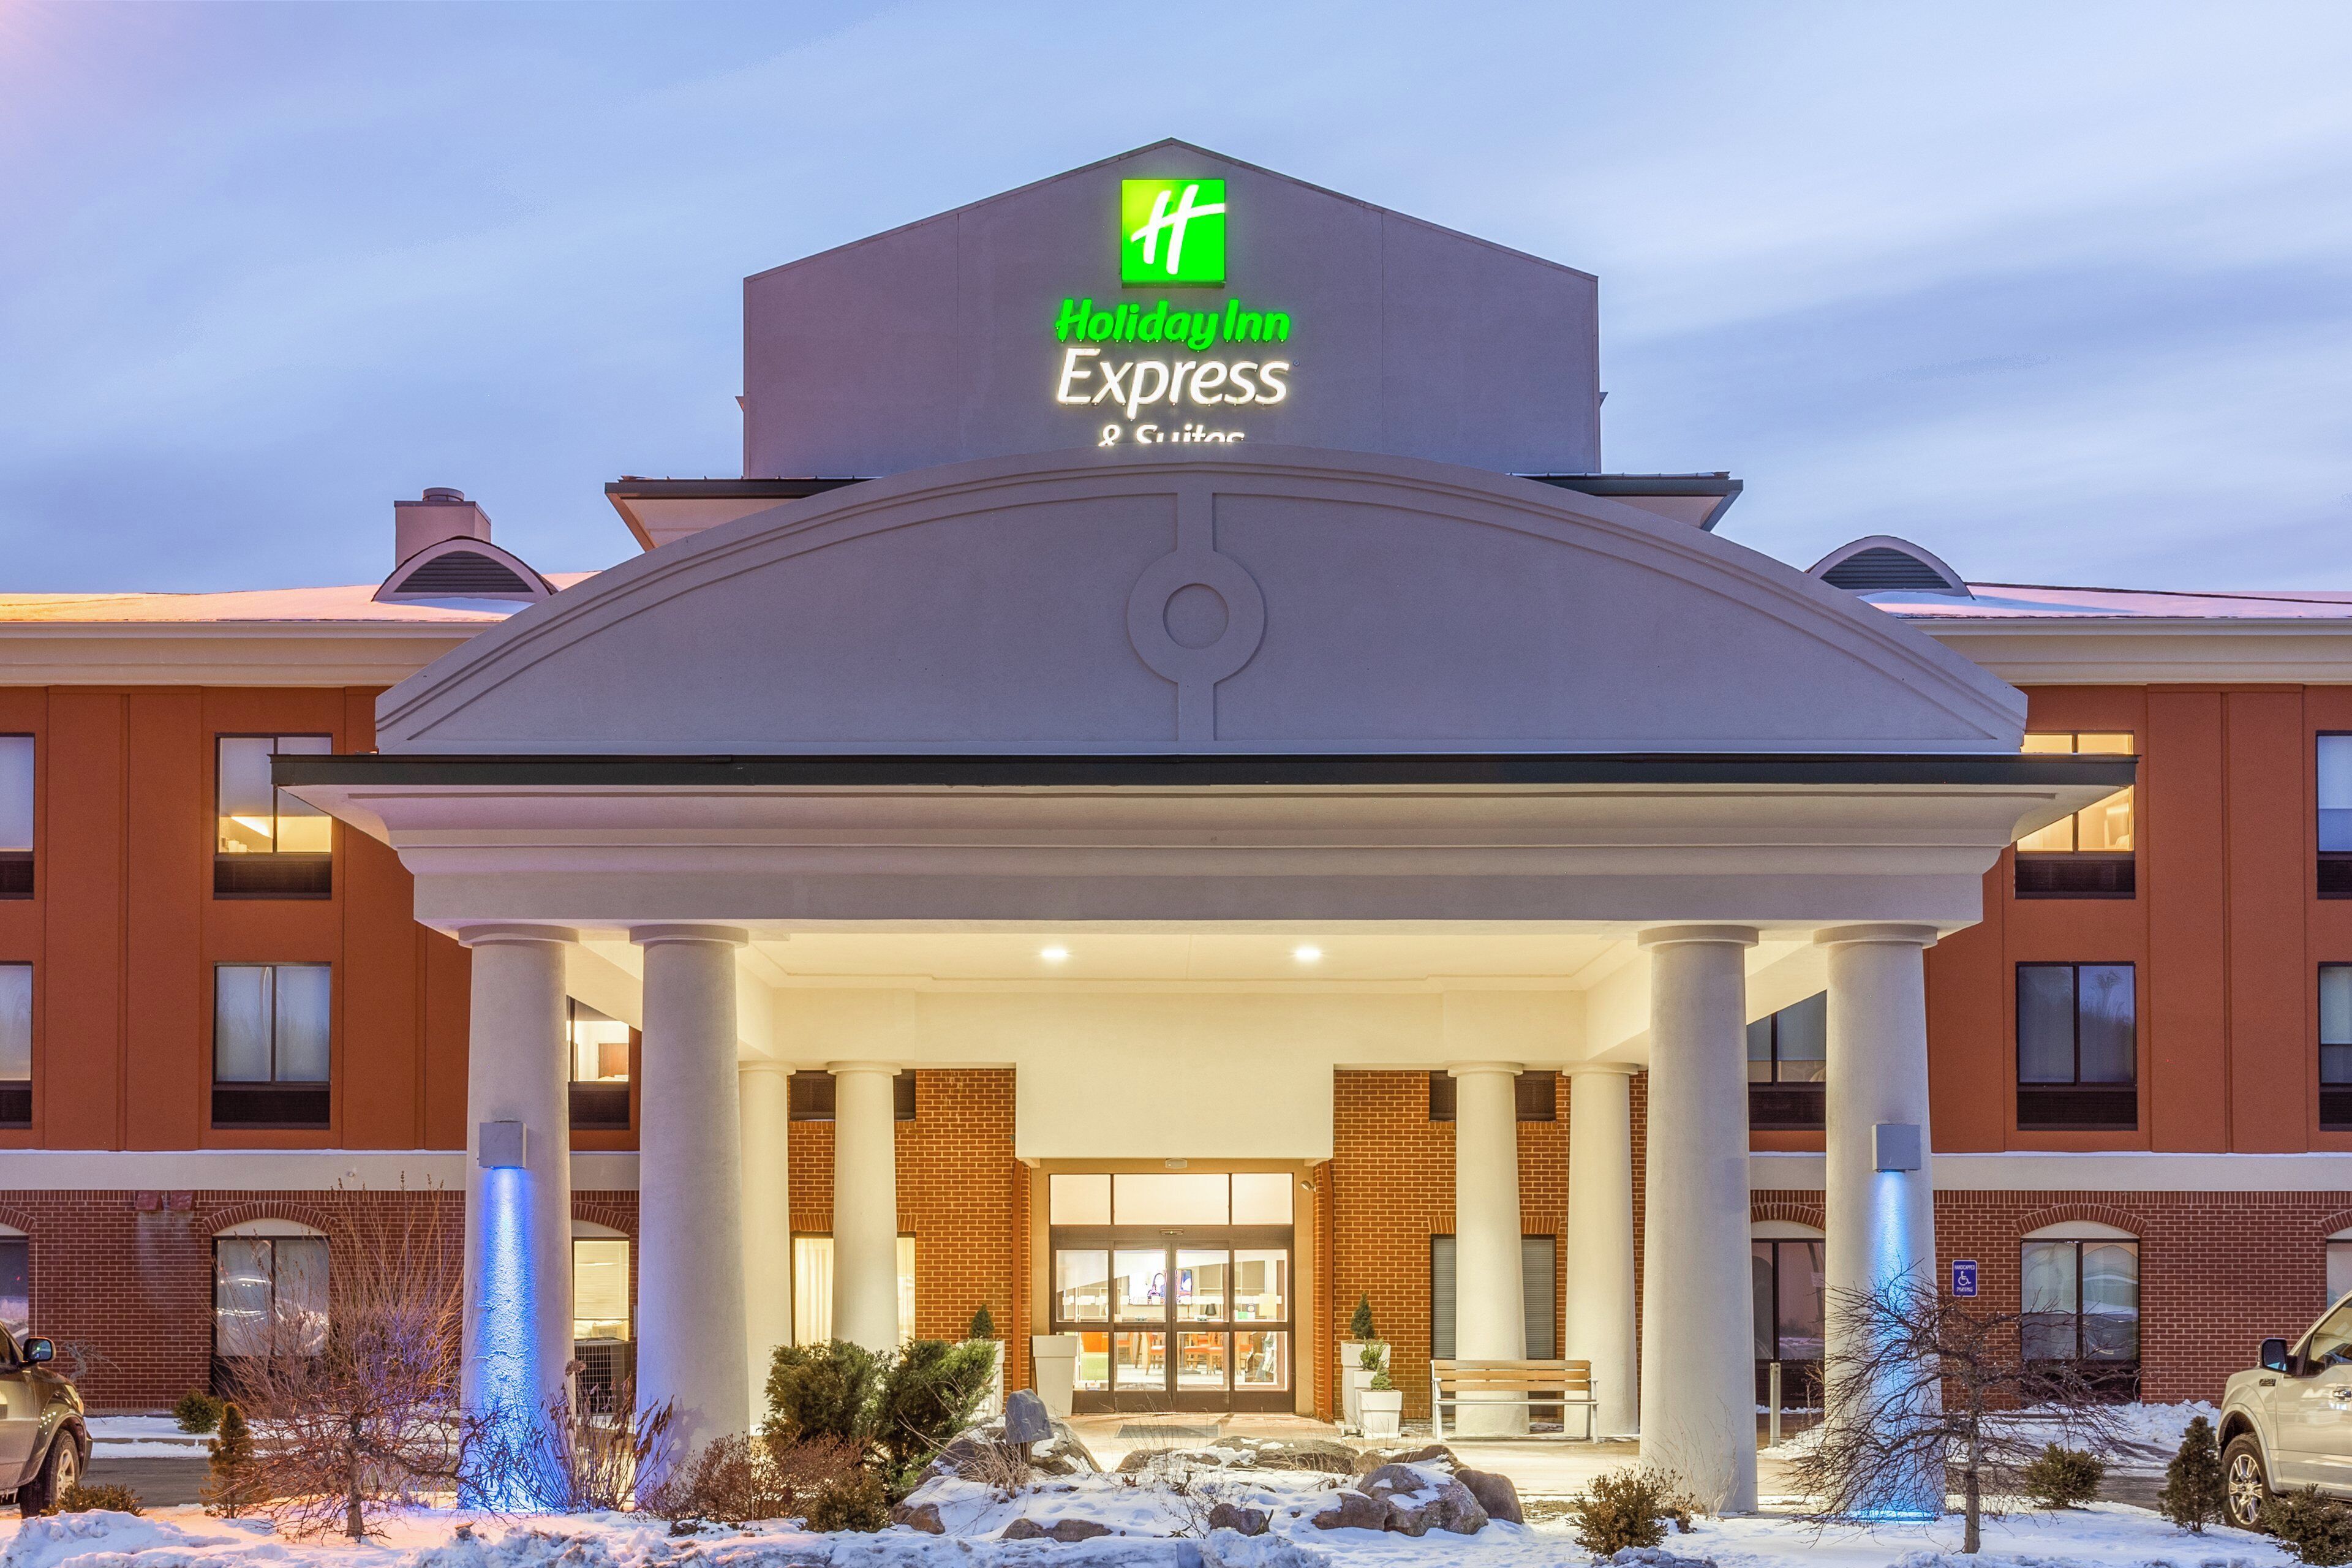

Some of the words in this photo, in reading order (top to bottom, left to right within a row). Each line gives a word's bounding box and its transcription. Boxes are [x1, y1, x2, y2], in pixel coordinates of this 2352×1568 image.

[1130, 184, 1225, 274] H
[1056, 299, 1218, 350] Holiday
[1224, 299, 1290, 342] Inn
[1057, 347, 1289, 420] Express
[1098, 424, 1121, 447] &
